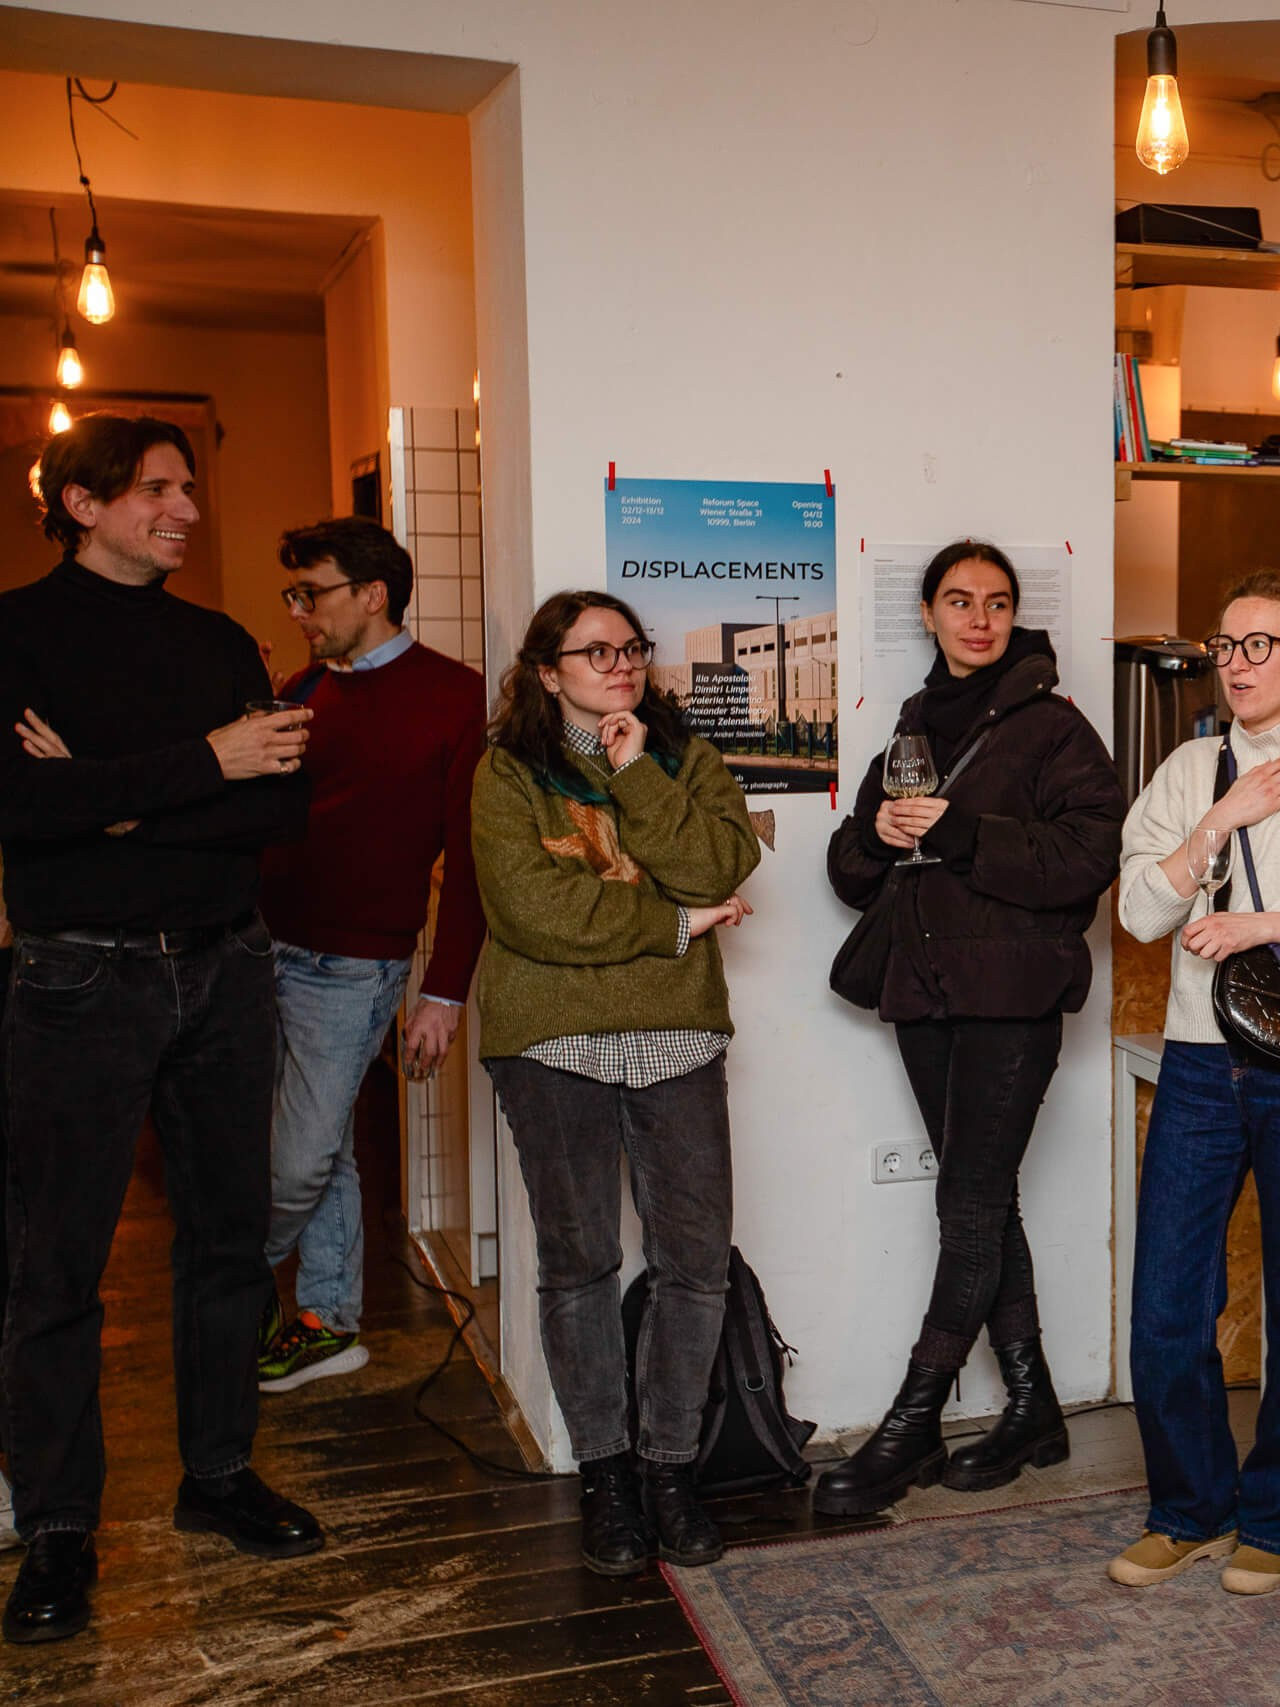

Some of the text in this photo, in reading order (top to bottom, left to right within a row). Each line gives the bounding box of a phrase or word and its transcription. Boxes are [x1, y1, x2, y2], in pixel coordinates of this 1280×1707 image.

[621, 496, 662, 505] Exhibition
[736, 499, 759, 509] Space
[792, 500, 823, 510] Opening
[700, 508, 726, 516] Wiener
[621, 516, 641, 525] 2024
[733, 518, 756, 527] Berlin
[621, 560, 824, 580] DISPLACEMENTS
[694, 685, 723, 694] Dimitri
[750, 782, 788, 790] photography
